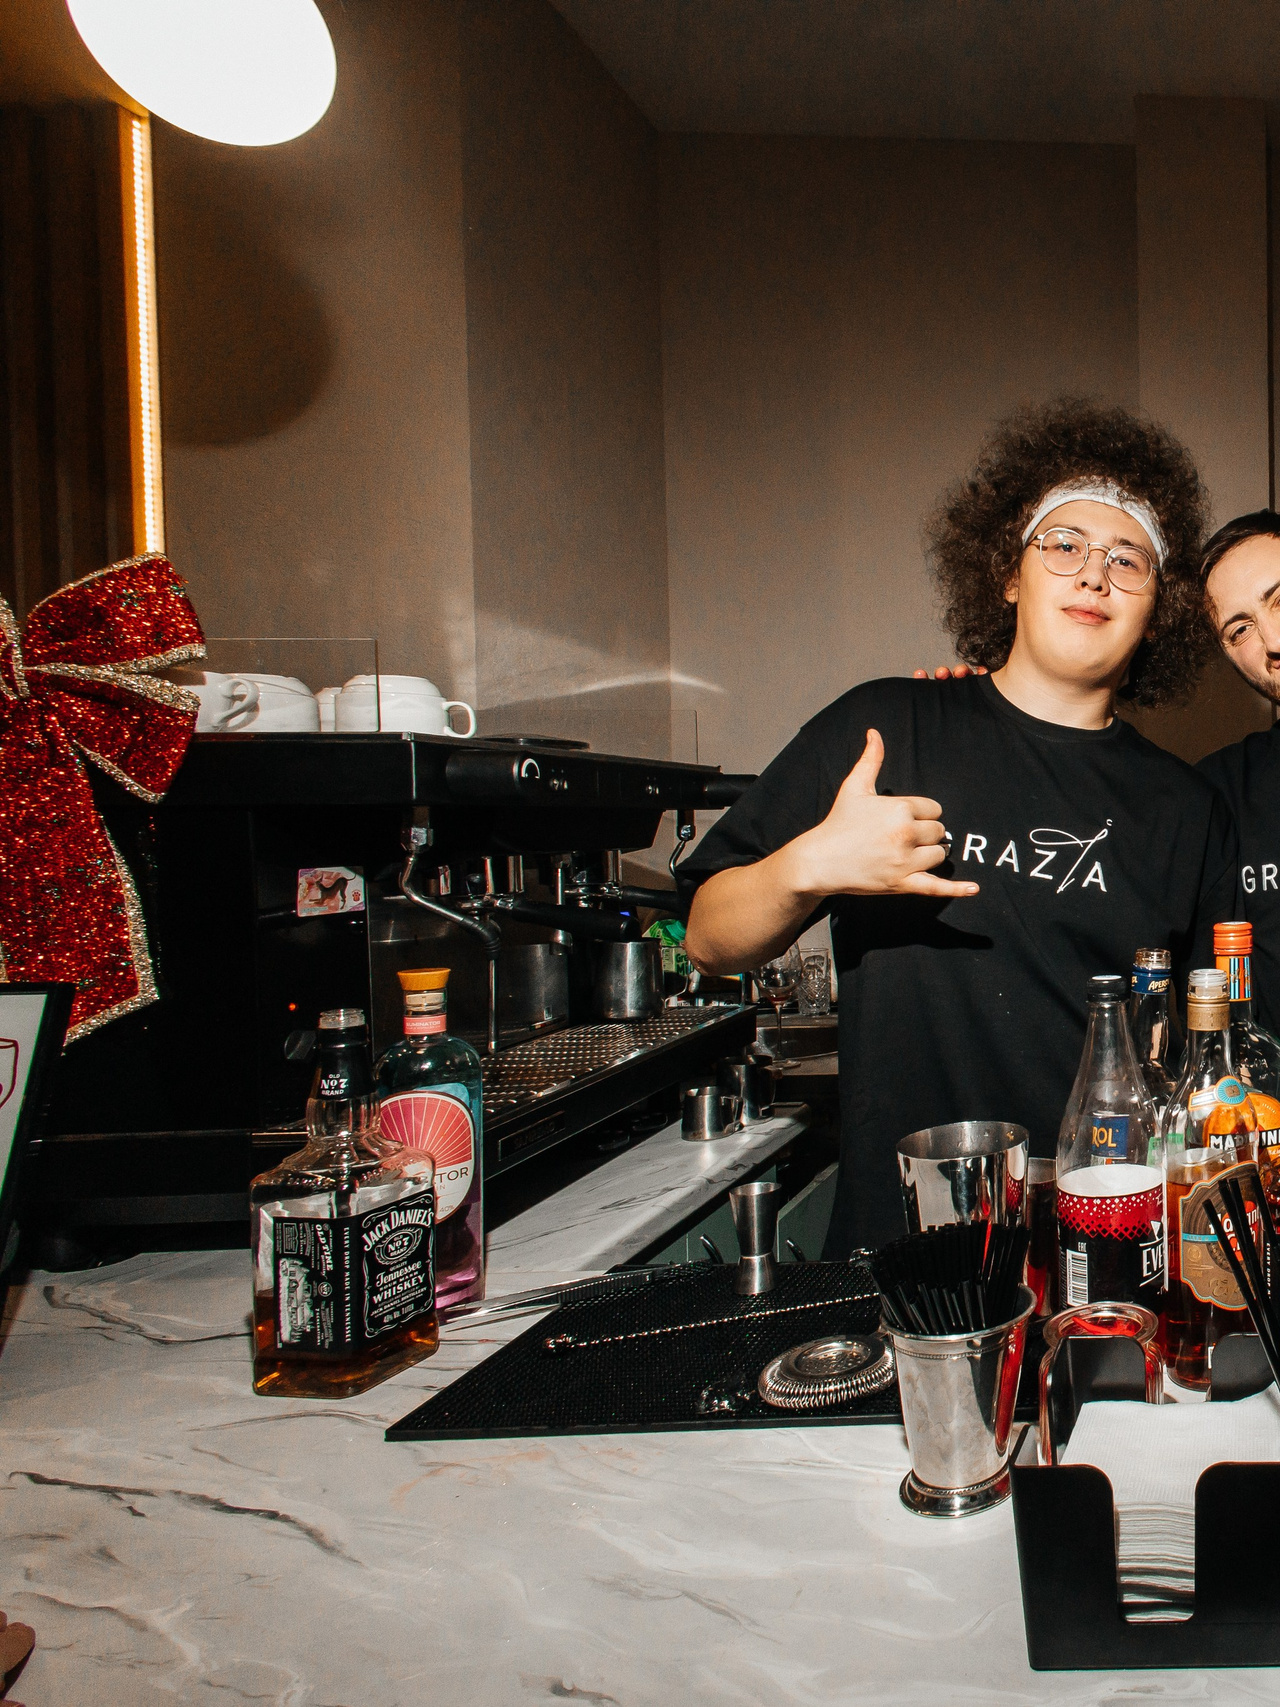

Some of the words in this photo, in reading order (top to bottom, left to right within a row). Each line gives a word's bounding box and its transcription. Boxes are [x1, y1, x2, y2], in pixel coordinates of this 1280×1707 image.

[321, 1089, 345, 1097] BRAND
[1092, 1126, 1117, 1148] ROL
[435, 1167, 469, 1183] TOR
[362, 1218, 391, 1252] JACK
[390, 1207, 435, 1229] DANIEL'S
[375, 1260, 422, 1287] Tennessee
[372, 1273, 426, 1304] WHISKEY
